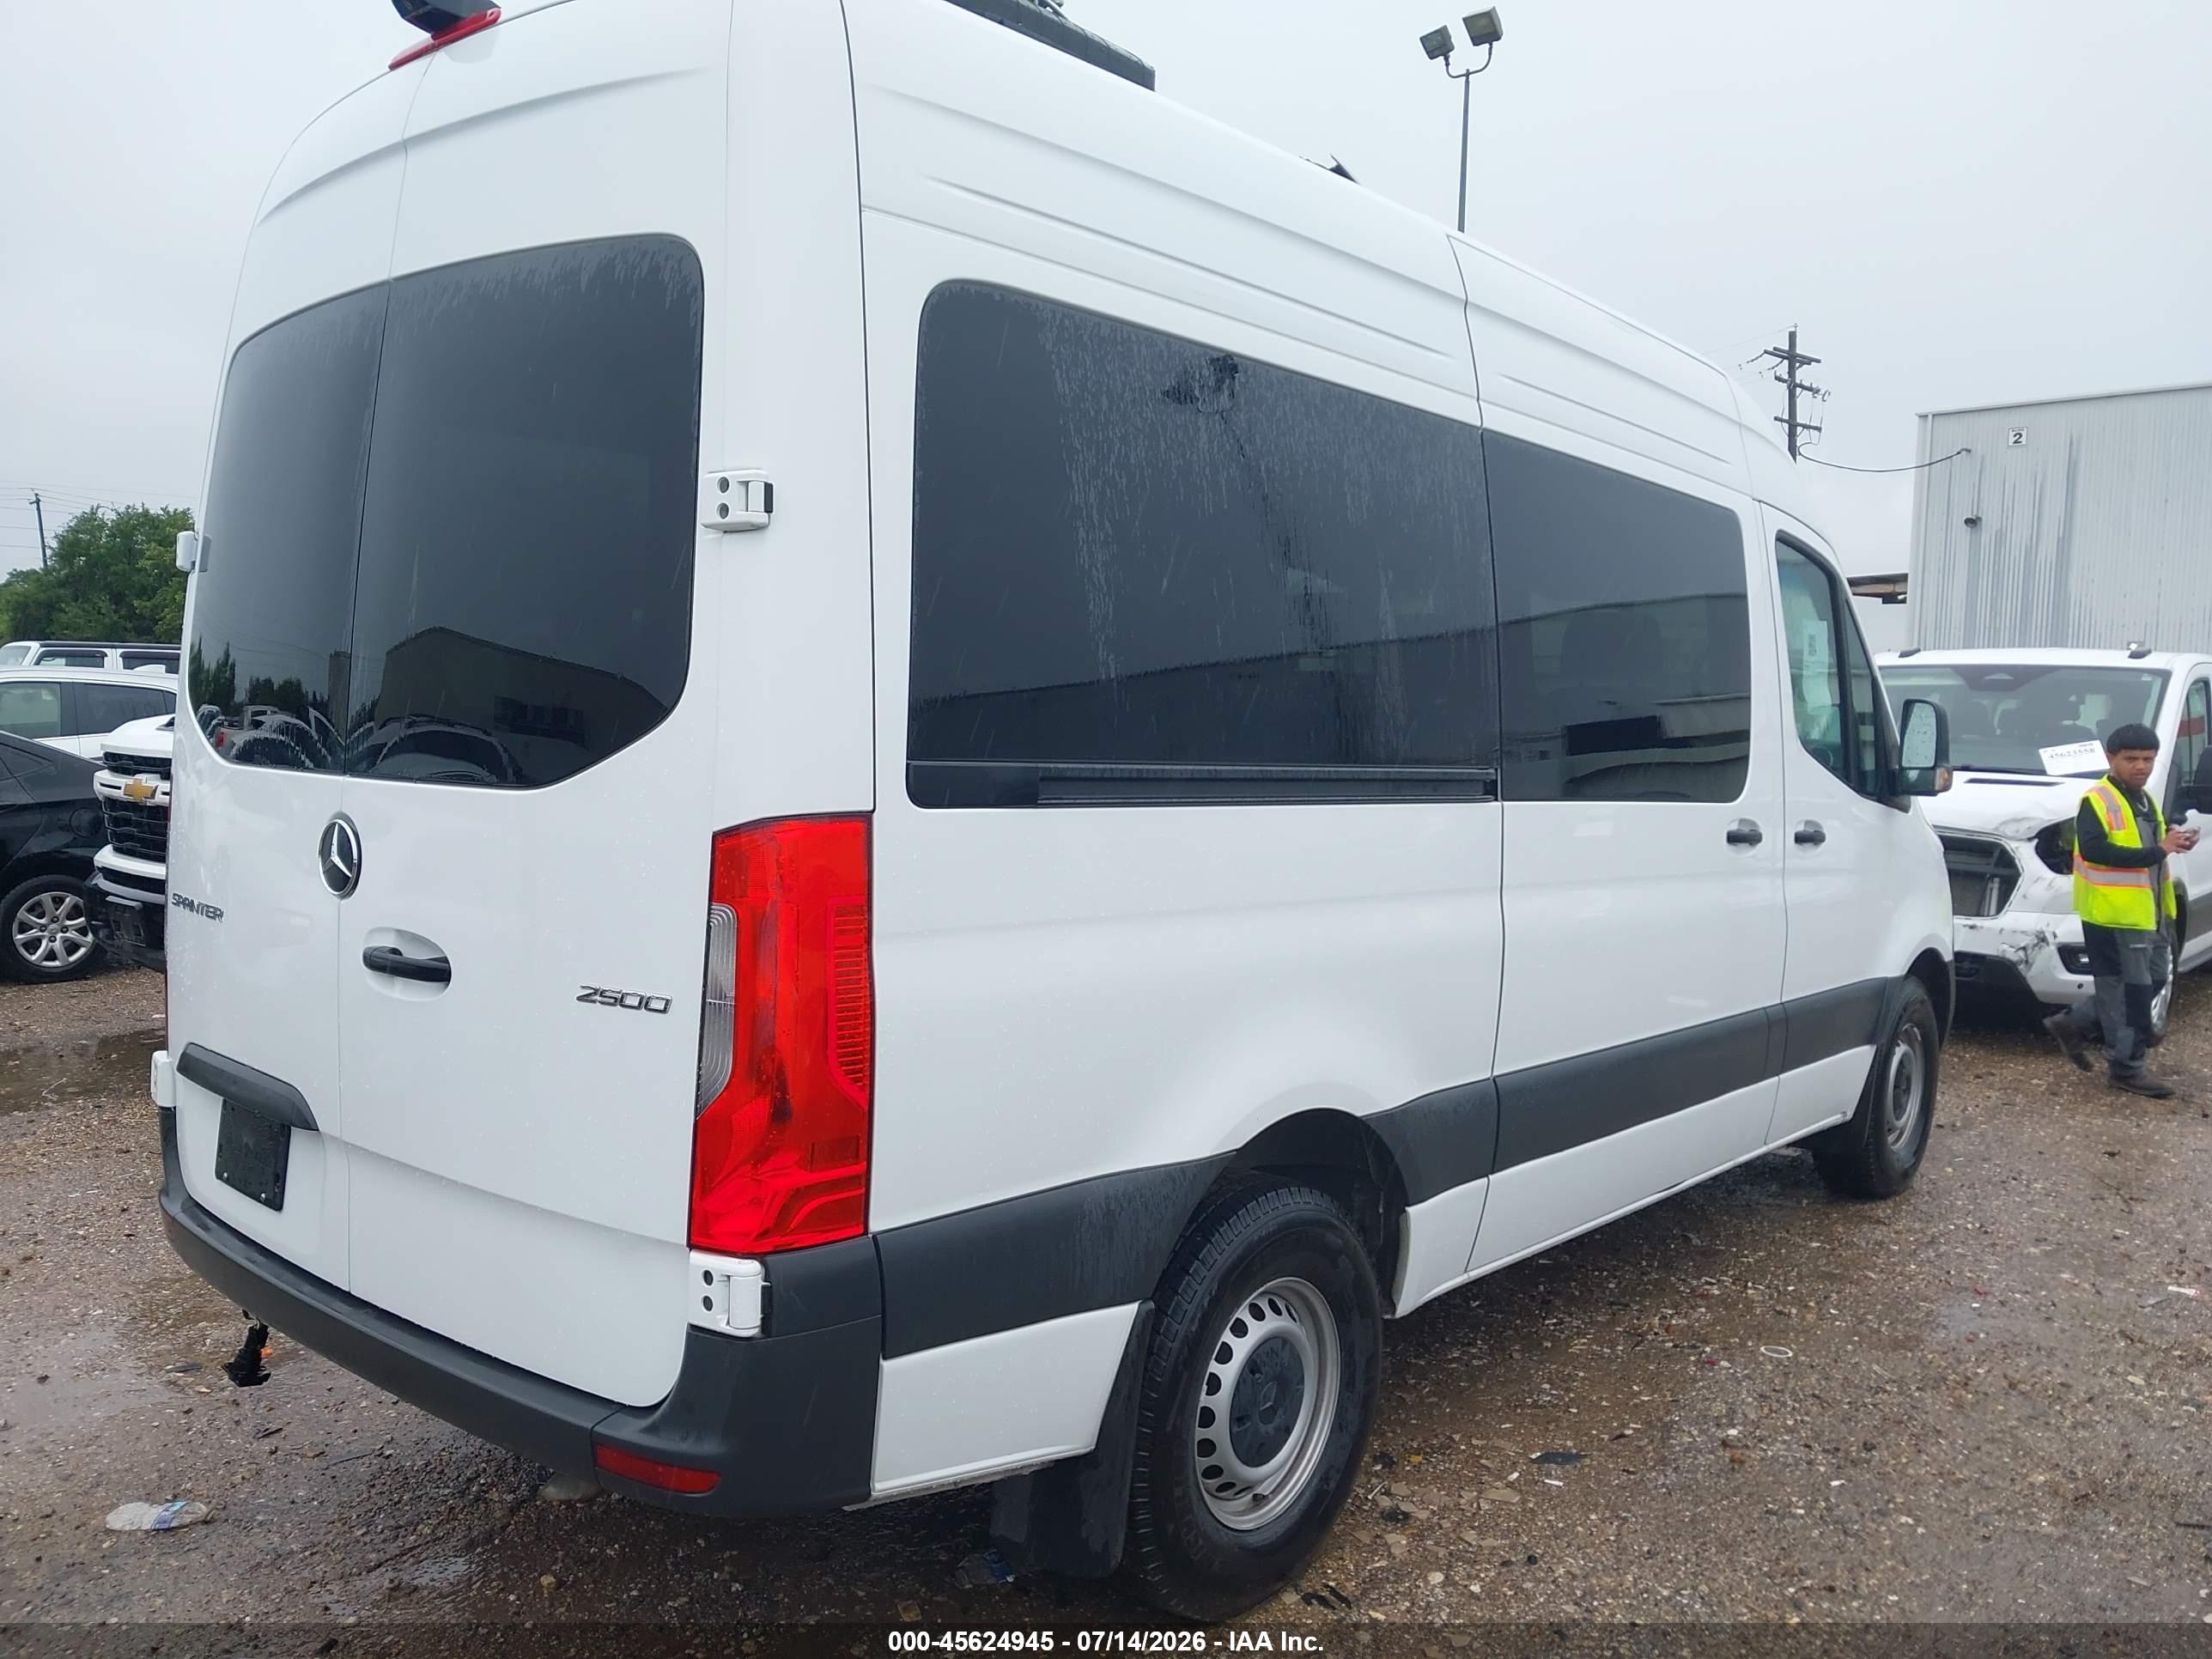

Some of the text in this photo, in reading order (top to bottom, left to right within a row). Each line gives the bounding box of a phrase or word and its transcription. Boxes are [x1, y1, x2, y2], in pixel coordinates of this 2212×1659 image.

[2013, 432, 2023, 444] 2
[171, 892, 225, 923] SPRINTER
[575, 985, 672, 1014] 2500
